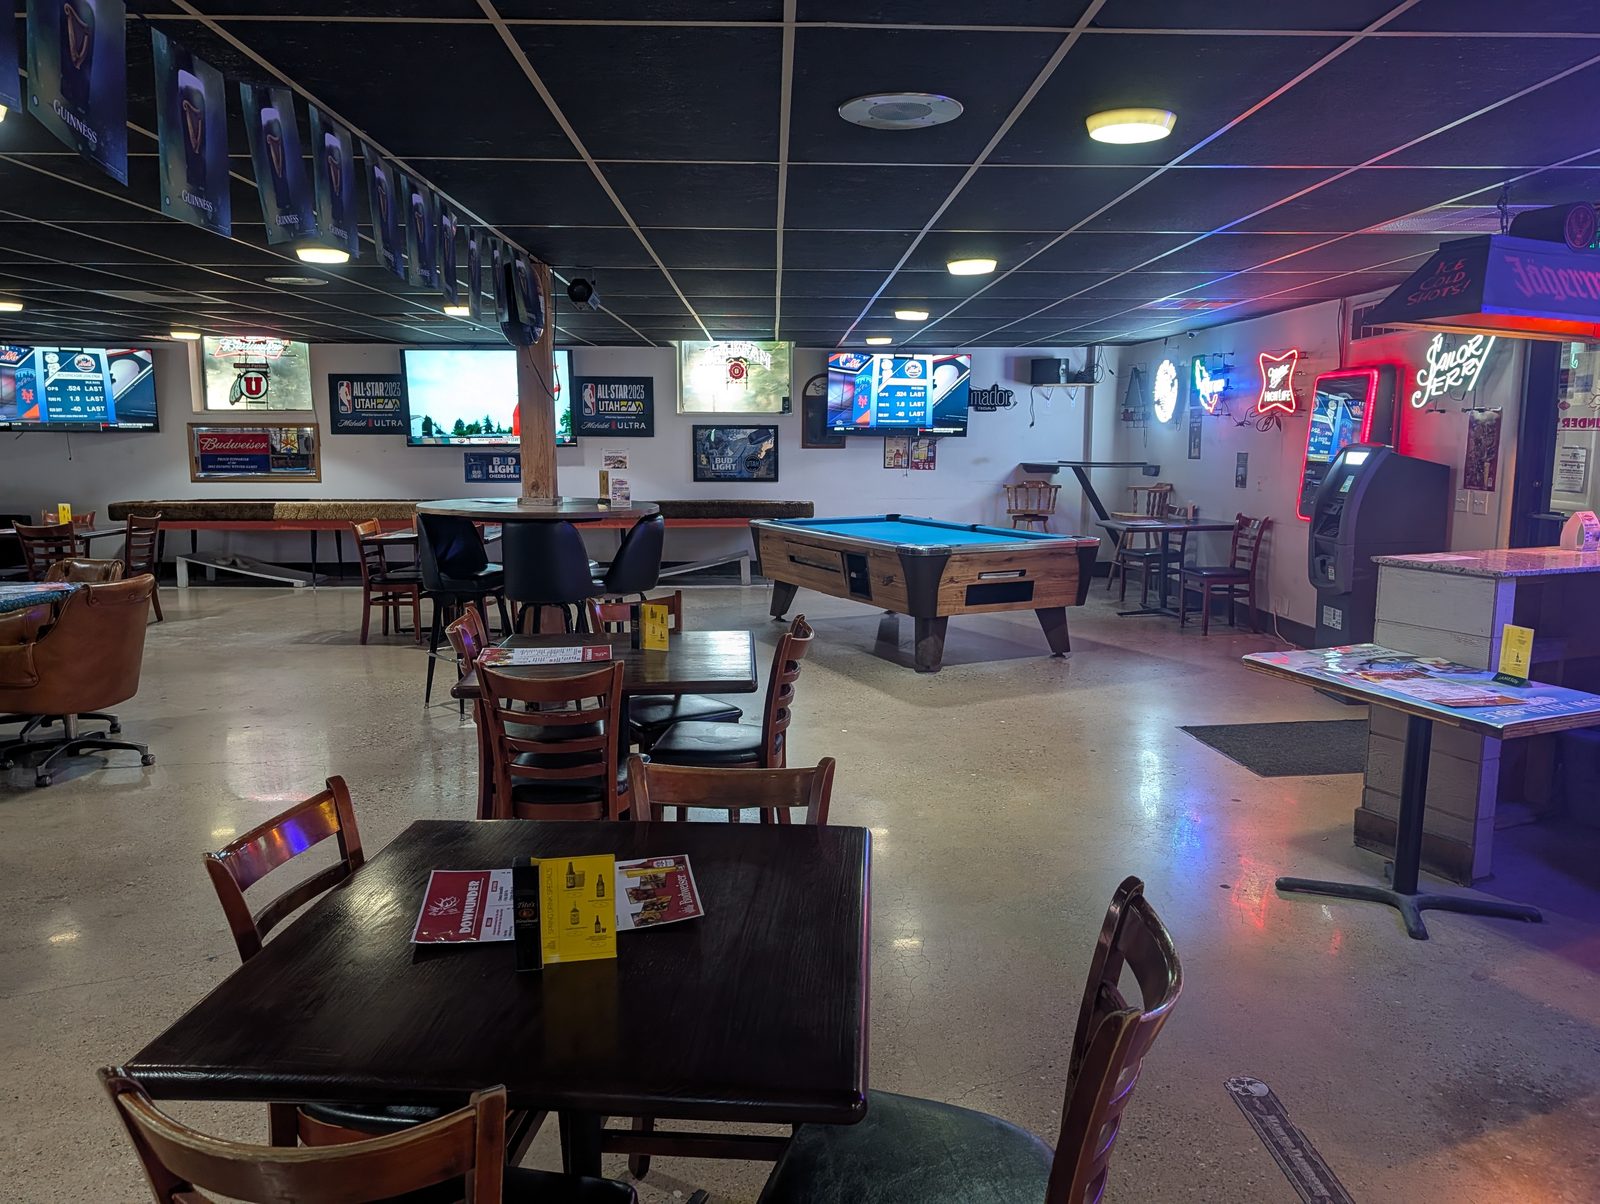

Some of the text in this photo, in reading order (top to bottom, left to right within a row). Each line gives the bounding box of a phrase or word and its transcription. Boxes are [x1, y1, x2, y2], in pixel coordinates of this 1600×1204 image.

[52, 99, 98, 144] GUINNESS
[181, 189, 214, 213] GUINNESS
[1435, 257, 1468, 275] ICE
[1420, 271, 1466, 291] COLD
[1407, 279, 1472, 306] SHOTS!
[244, 376, 263, 396] U
[384, 381, 402, 397] 2023
[628, 384, 645, 399] 2023
[354, 398, 376, 409] UTAH
[970, 385, 1014, 406] mador
[598, 400, 620, 411] UTAH
[374, 419, 404, 427] ULTRA
[200, 437, 268, 451] Budweiser
[492, 457, 517, 465] BUD
[488, 465, 520, 474] LIGHT
[459, 880, 480, 934] DOWNUNDER
[517, 901, 536, 909] Tito's
